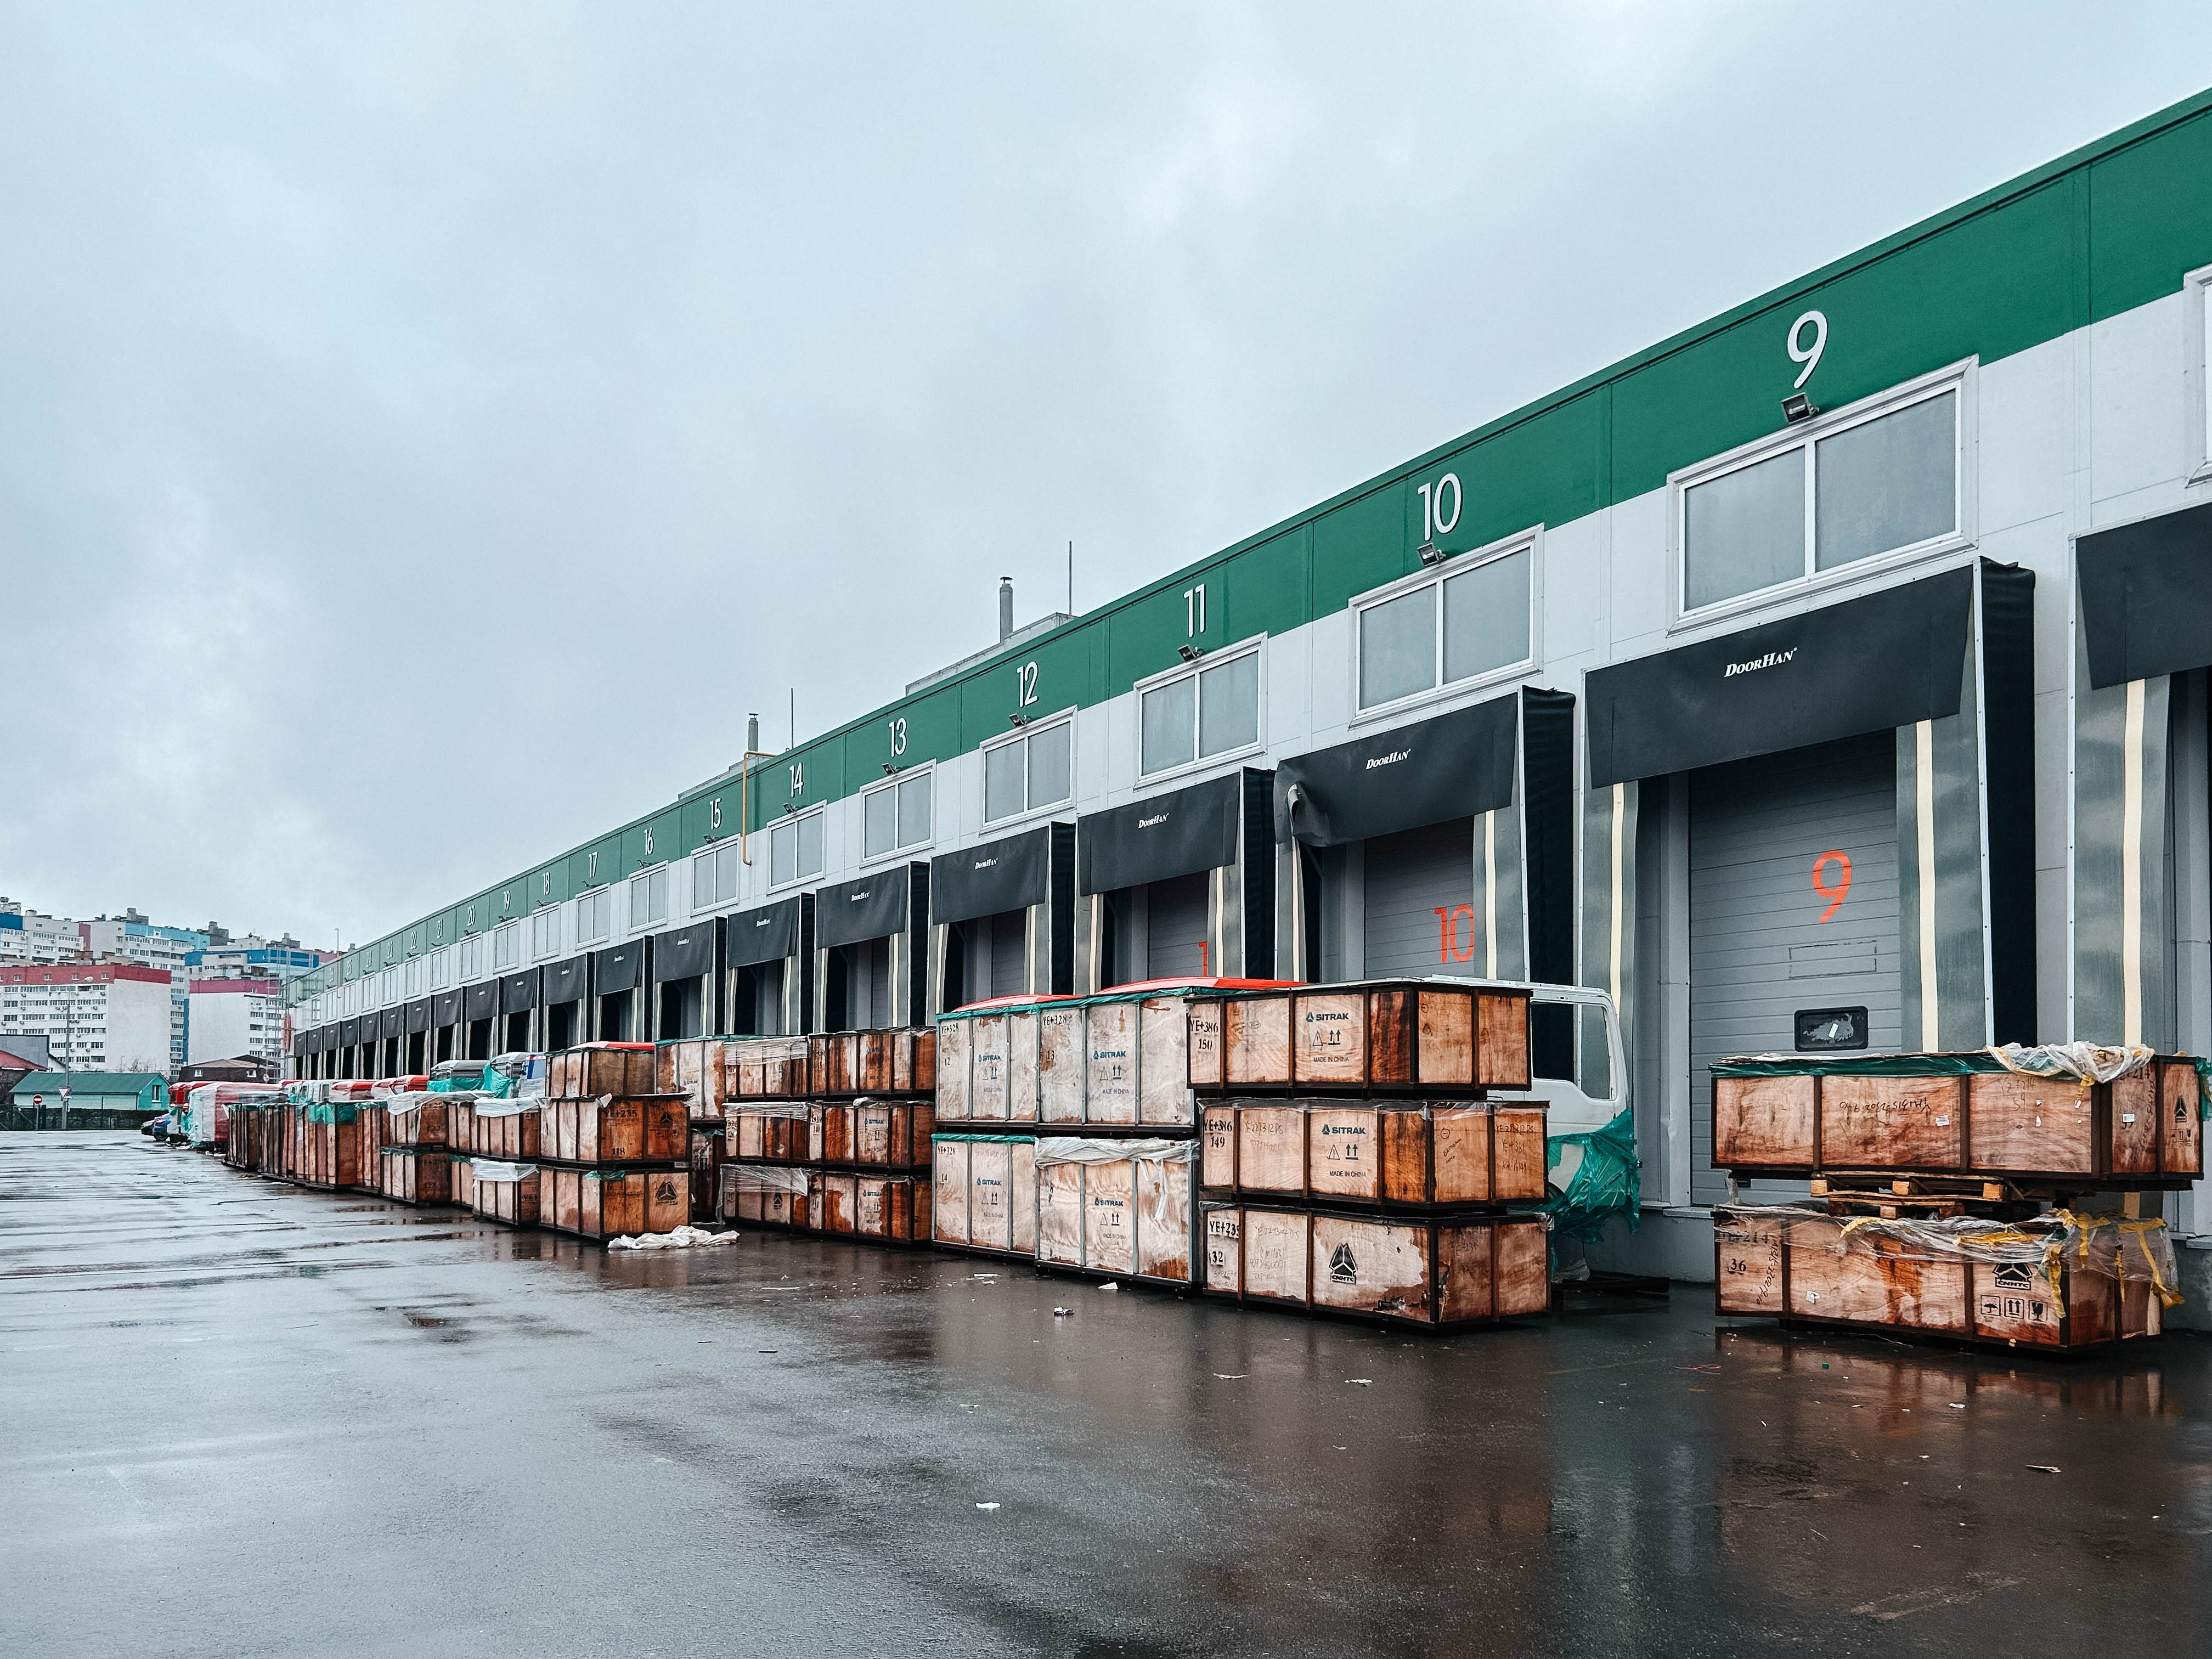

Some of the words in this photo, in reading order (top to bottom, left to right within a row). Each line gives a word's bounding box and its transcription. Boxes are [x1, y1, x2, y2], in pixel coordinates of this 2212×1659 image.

[1787, 311, 1828, 389] 9
[1418, 473, 1463, 541] 10
[1183, 584, 1206, 638] 11
[1017, 661, 1039, 707] 12
[888, 718, 907, 758] 13
[789, 762, 804, 797] 14
[709, 797, 722, 830] 15
[644, 827, 654, 855] 16
[589, 851, 599, 878] 17
[543, 872, 550, 895] 18
[1812, 850, 1852, 924] 9
[504, 890, 511, 912] 19
[467, 905, 476, 927] 20
[437, 919, 444, 939] 21
[1435, 905, 1475, 964] 10
[1043, 1015, 1067, 1026] YE+328
[1099, 1051, 1126, 1059] SITRAK
[1198, 1039, 1212, 1049] 150
[945, 1057, 950, 1066] 12
[1047, 1050, 1054, 1061] 13
[603, 1109, 637, 1118] YE+235
[612, 1147, 625, 1155] 118
[1210, 1136, 1226, 1148] 149
[941, 1173, 947, 1182] 14
[1731, 1259, 1747, 1272] 36
[1997, 1280, 2029, 1288] CNHTC
